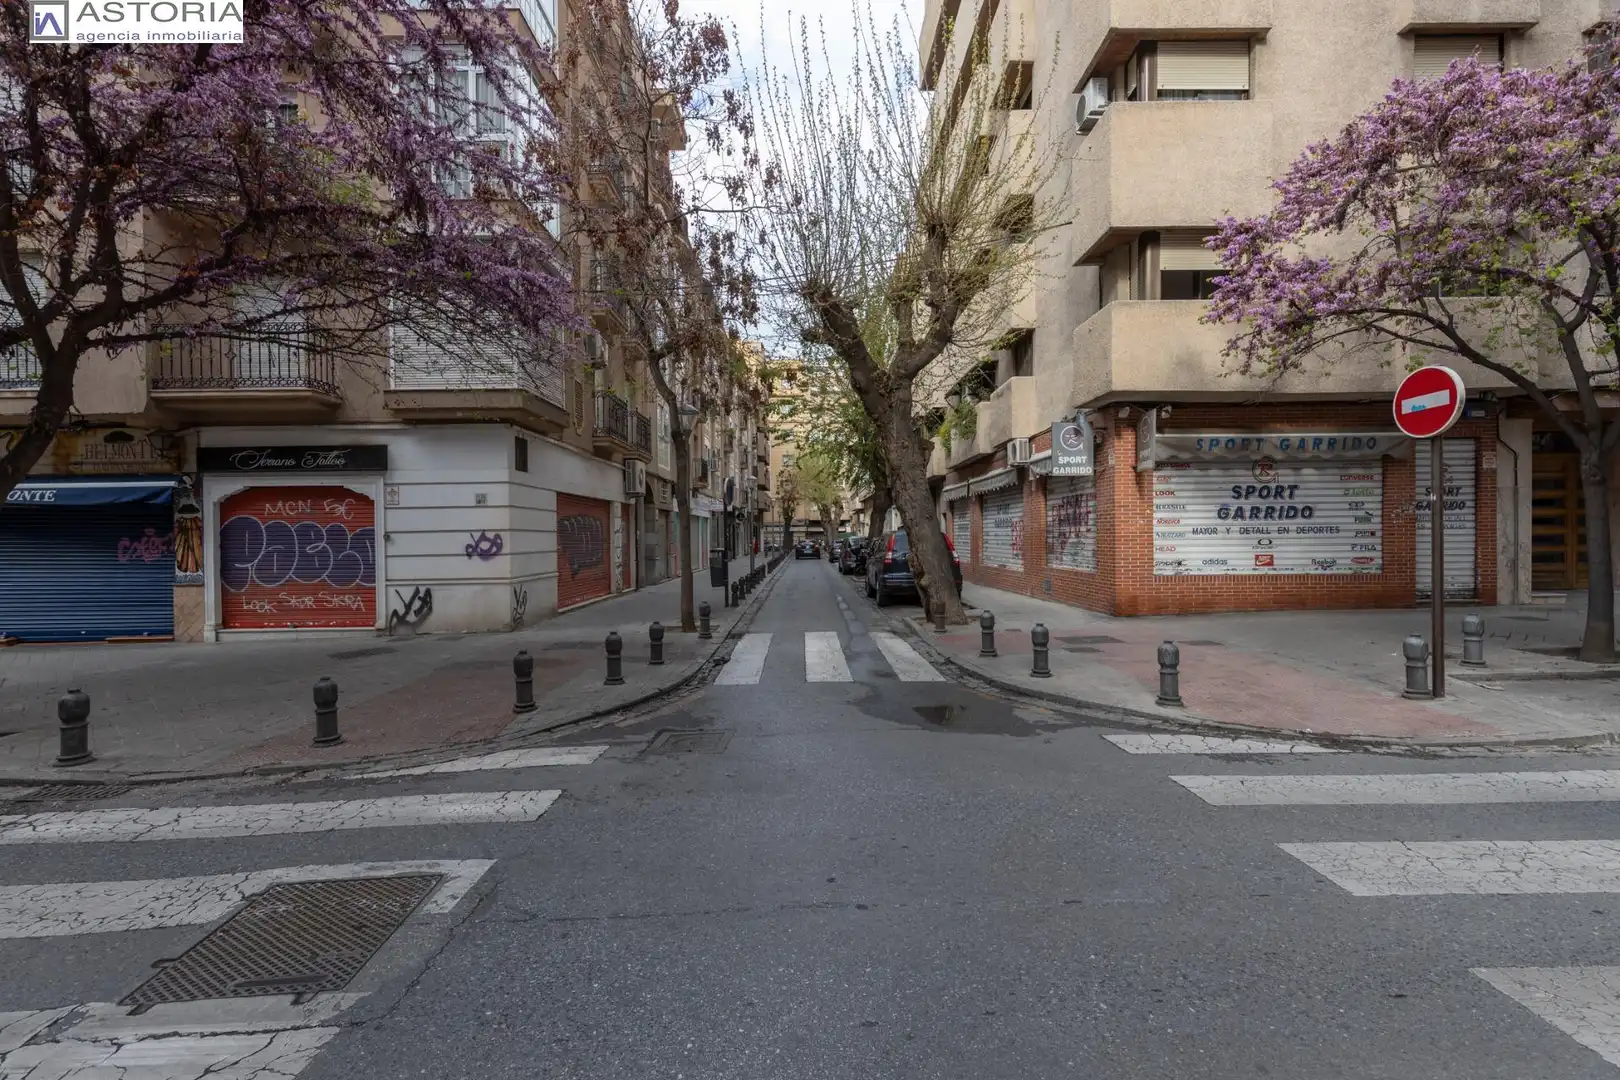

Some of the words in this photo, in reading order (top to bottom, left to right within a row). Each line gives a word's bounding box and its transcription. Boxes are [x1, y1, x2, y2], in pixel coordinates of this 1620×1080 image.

[1196, 437, 1267, 452] SPORT
[1279, 436, 1378, 450] GARRIDO
[301, 448, 352, 468] Tattoo
[1058, 456, 1088, 464] SPORT
[1053, 466, 1093, 474] GARRIDO
[1231, 484, 1300, 500] SPORT
[1216, 504, 1316, 521] GARRIDO
[1192, 527, 1218, 536] MAYOR
[1225, 527, 1231, 535] Y
[1239, 527, 1271, 535] DETALL
[1278, 526, 1290, 534] EN
[1296, 525, 1341, 535] DEPORTES
[1311, 558, 1337, 566] Reebok
